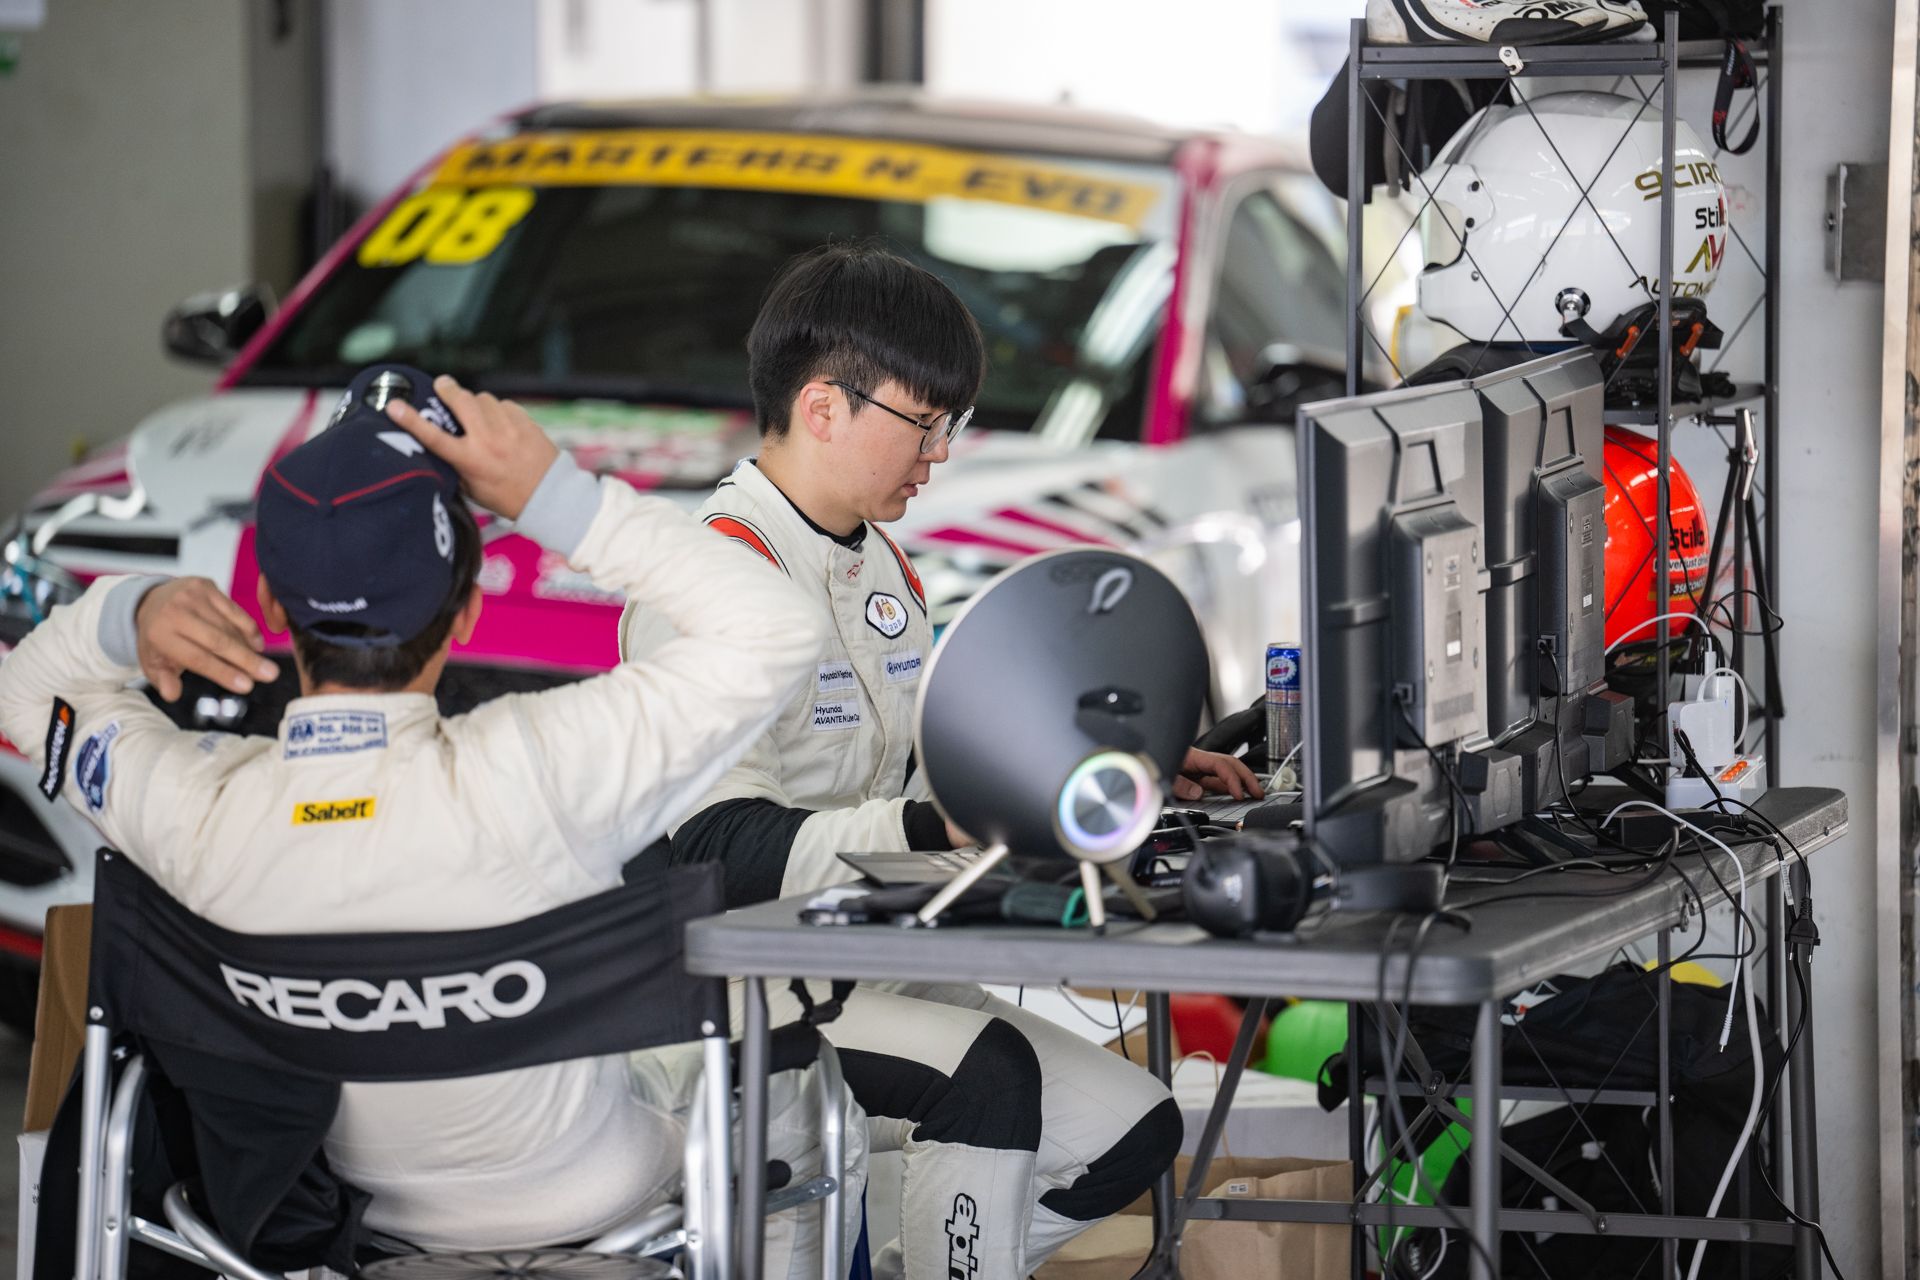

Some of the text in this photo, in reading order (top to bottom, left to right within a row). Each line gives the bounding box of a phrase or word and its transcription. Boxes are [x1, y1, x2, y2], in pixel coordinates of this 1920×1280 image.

[357, 187, 537, 268] 08
[1695, 192, 1725, 230] Stil
[815, 704, 843, 716] Hyundai
[815, 715, 842, 725] AVANTE
[302, 800, 368, 823] Sabelt
[219, 960, 547, 1032] RECARO
[944, 1192, 980, 1280] alpin
